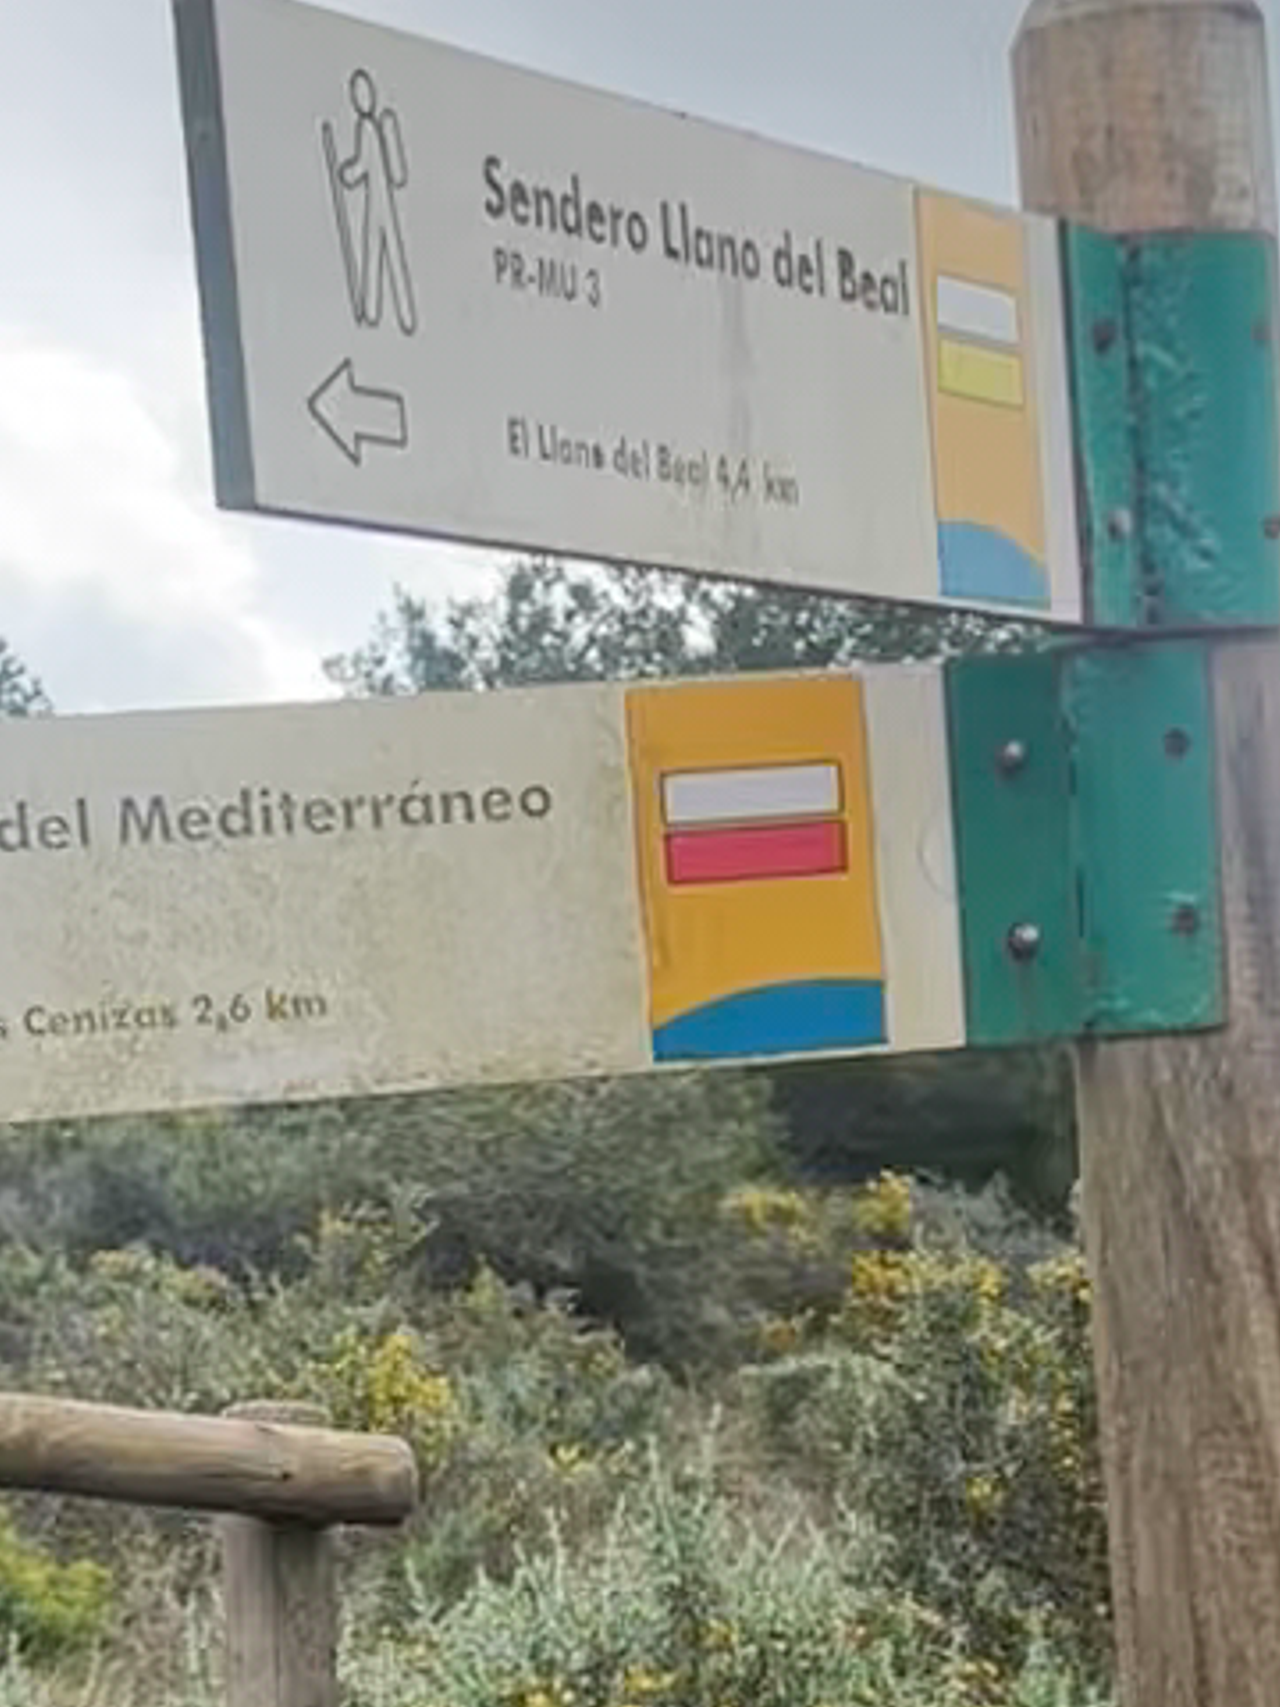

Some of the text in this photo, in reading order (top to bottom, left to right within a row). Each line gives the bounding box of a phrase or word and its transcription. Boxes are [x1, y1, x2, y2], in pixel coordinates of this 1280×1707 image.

[483, 154, 910, 317] Sendero Llano del Beal
[493, 247, 602, 309] PR-MU 3
[507, 416, 529, 459] El
[538, 424, 605, 469] Llano
[613, 436, 650, 481] del
[764, 461, 800, 506] km
[120, 779, 552, 847] Mediterráneo
[23, 997, 179, 1036] Cenizas
[192, 993, 252, 1032] 2,6
[265, 988, 327, 1021] km
